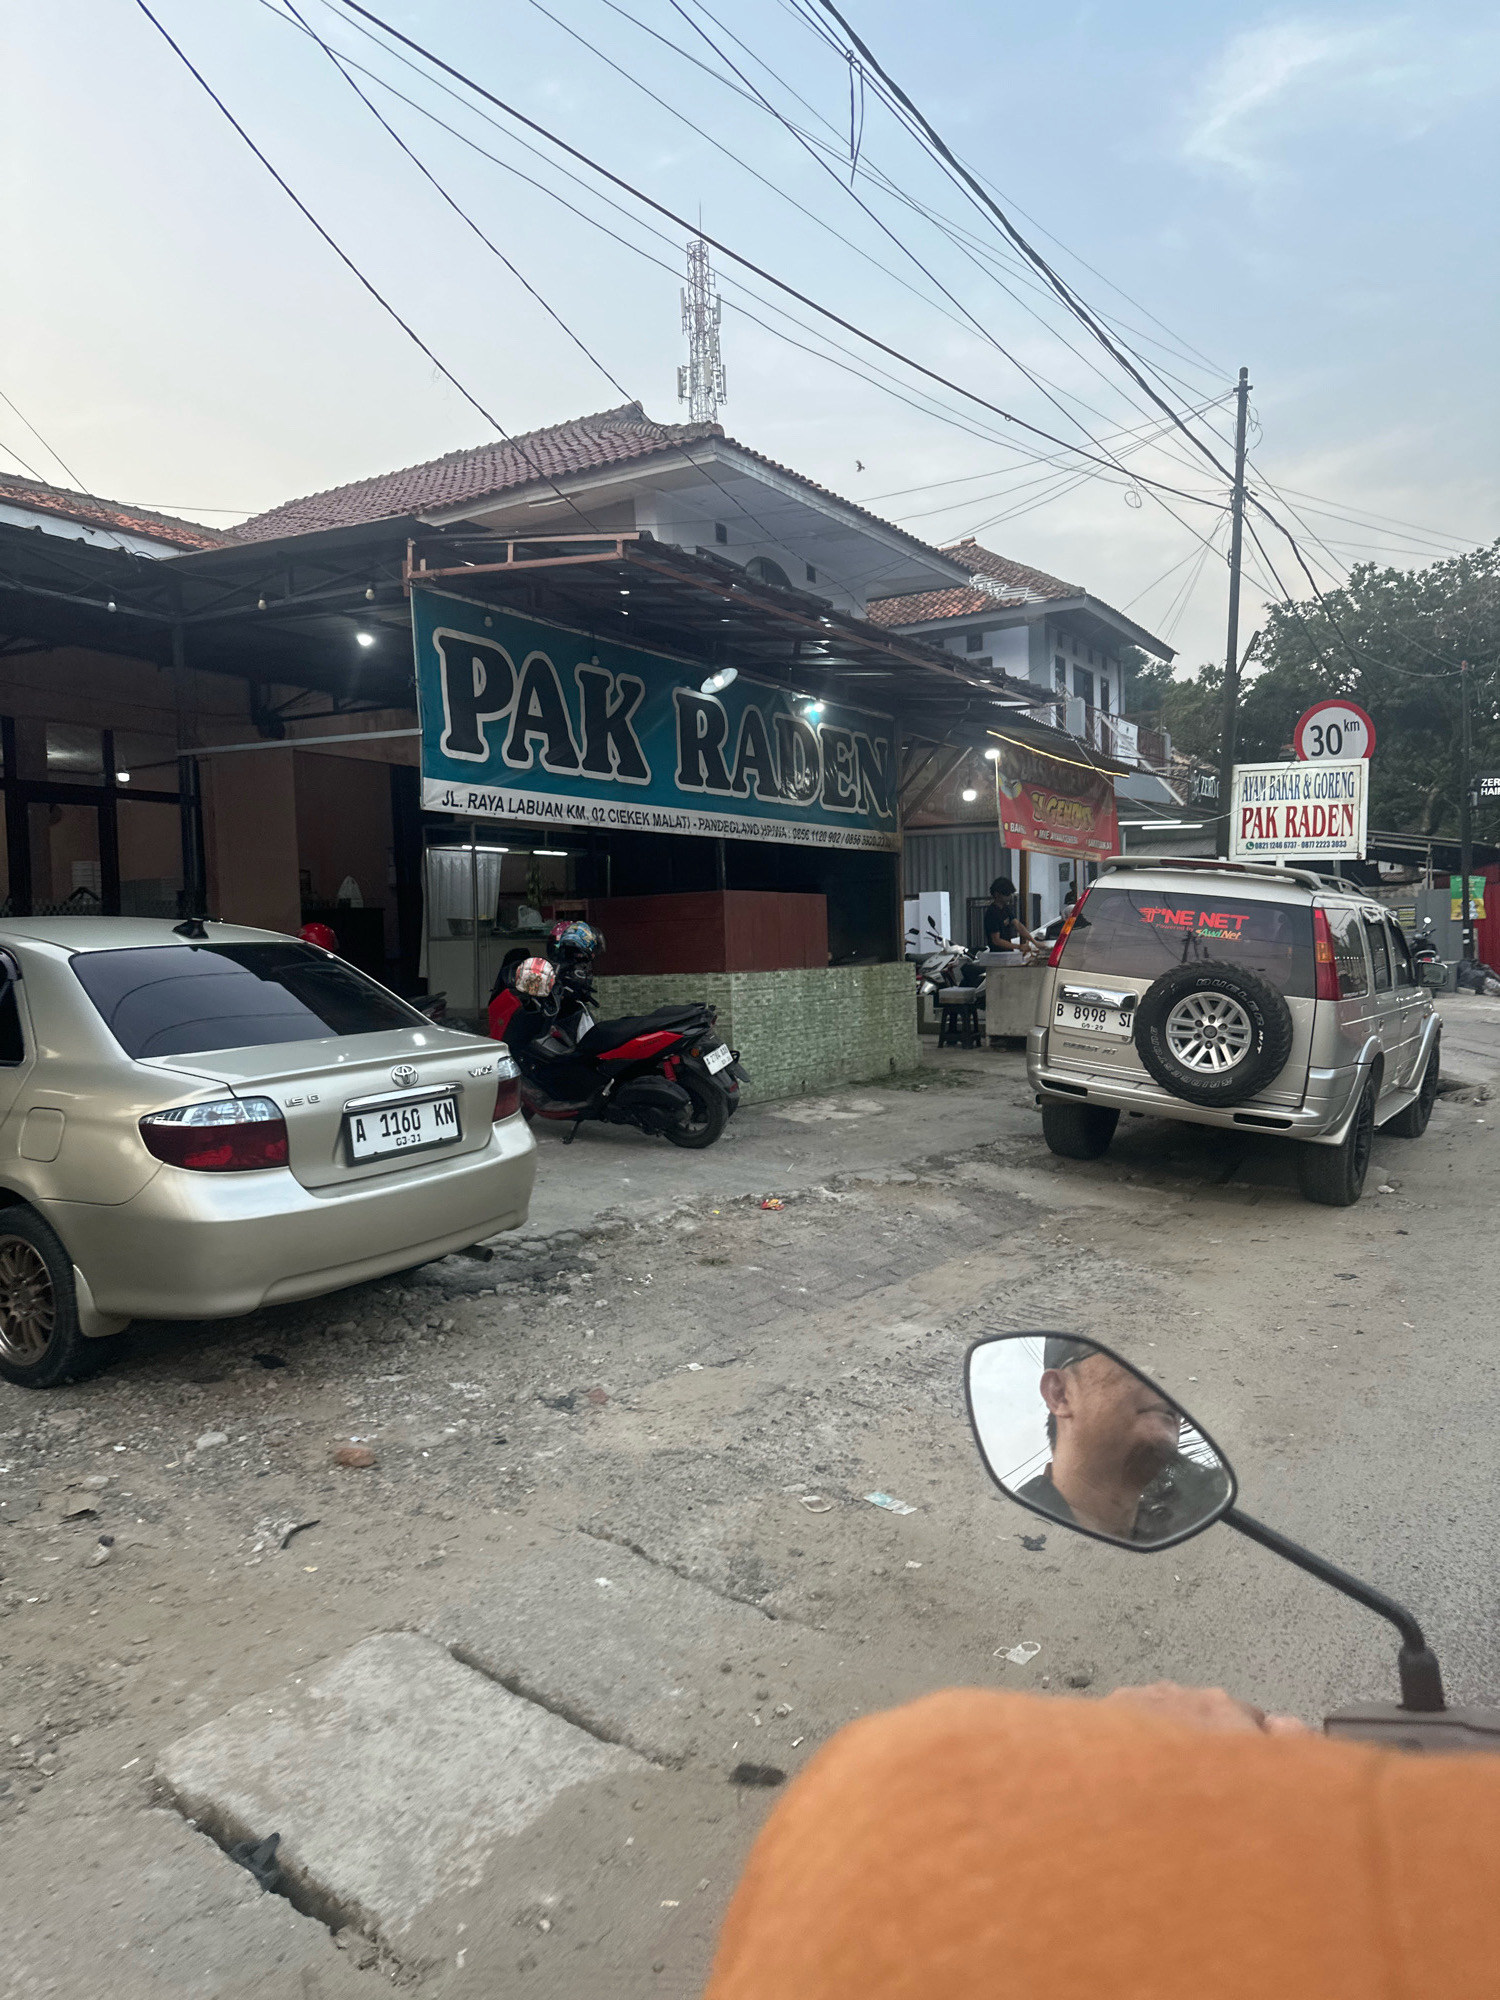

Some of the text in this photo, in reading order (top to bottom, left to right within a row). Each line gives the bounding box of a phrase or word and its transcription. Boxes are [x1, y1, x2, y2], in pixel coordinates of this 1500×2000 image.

[432, 627, 892, 818] PAK RADEN
[1310, 719, 1360, 757] 30 km
[1242, 771, 1355, 802] AYAM BAKAR & GORENG
[441, 790, 463, 808] JL.
[467, 792, 504, 813] RAYA
[508, 799, 563, 818] LABUAN
[566, 804, 589, 820] KM.
[592, 807, 606, 822] 02
[608, 810, 650, 827] CIEKEK
[653, 812, 691, 830] MALATI
[698, 817, 760, 836] PANDEGLANG
[1241, 803, 1354, 839] PAK RADEN
[1198, 911, 1250, 931] NET
[1057, 1003, 1132, 1029] B 8998 SI
[356, 1101, 455, 1143] A 1160 KN
